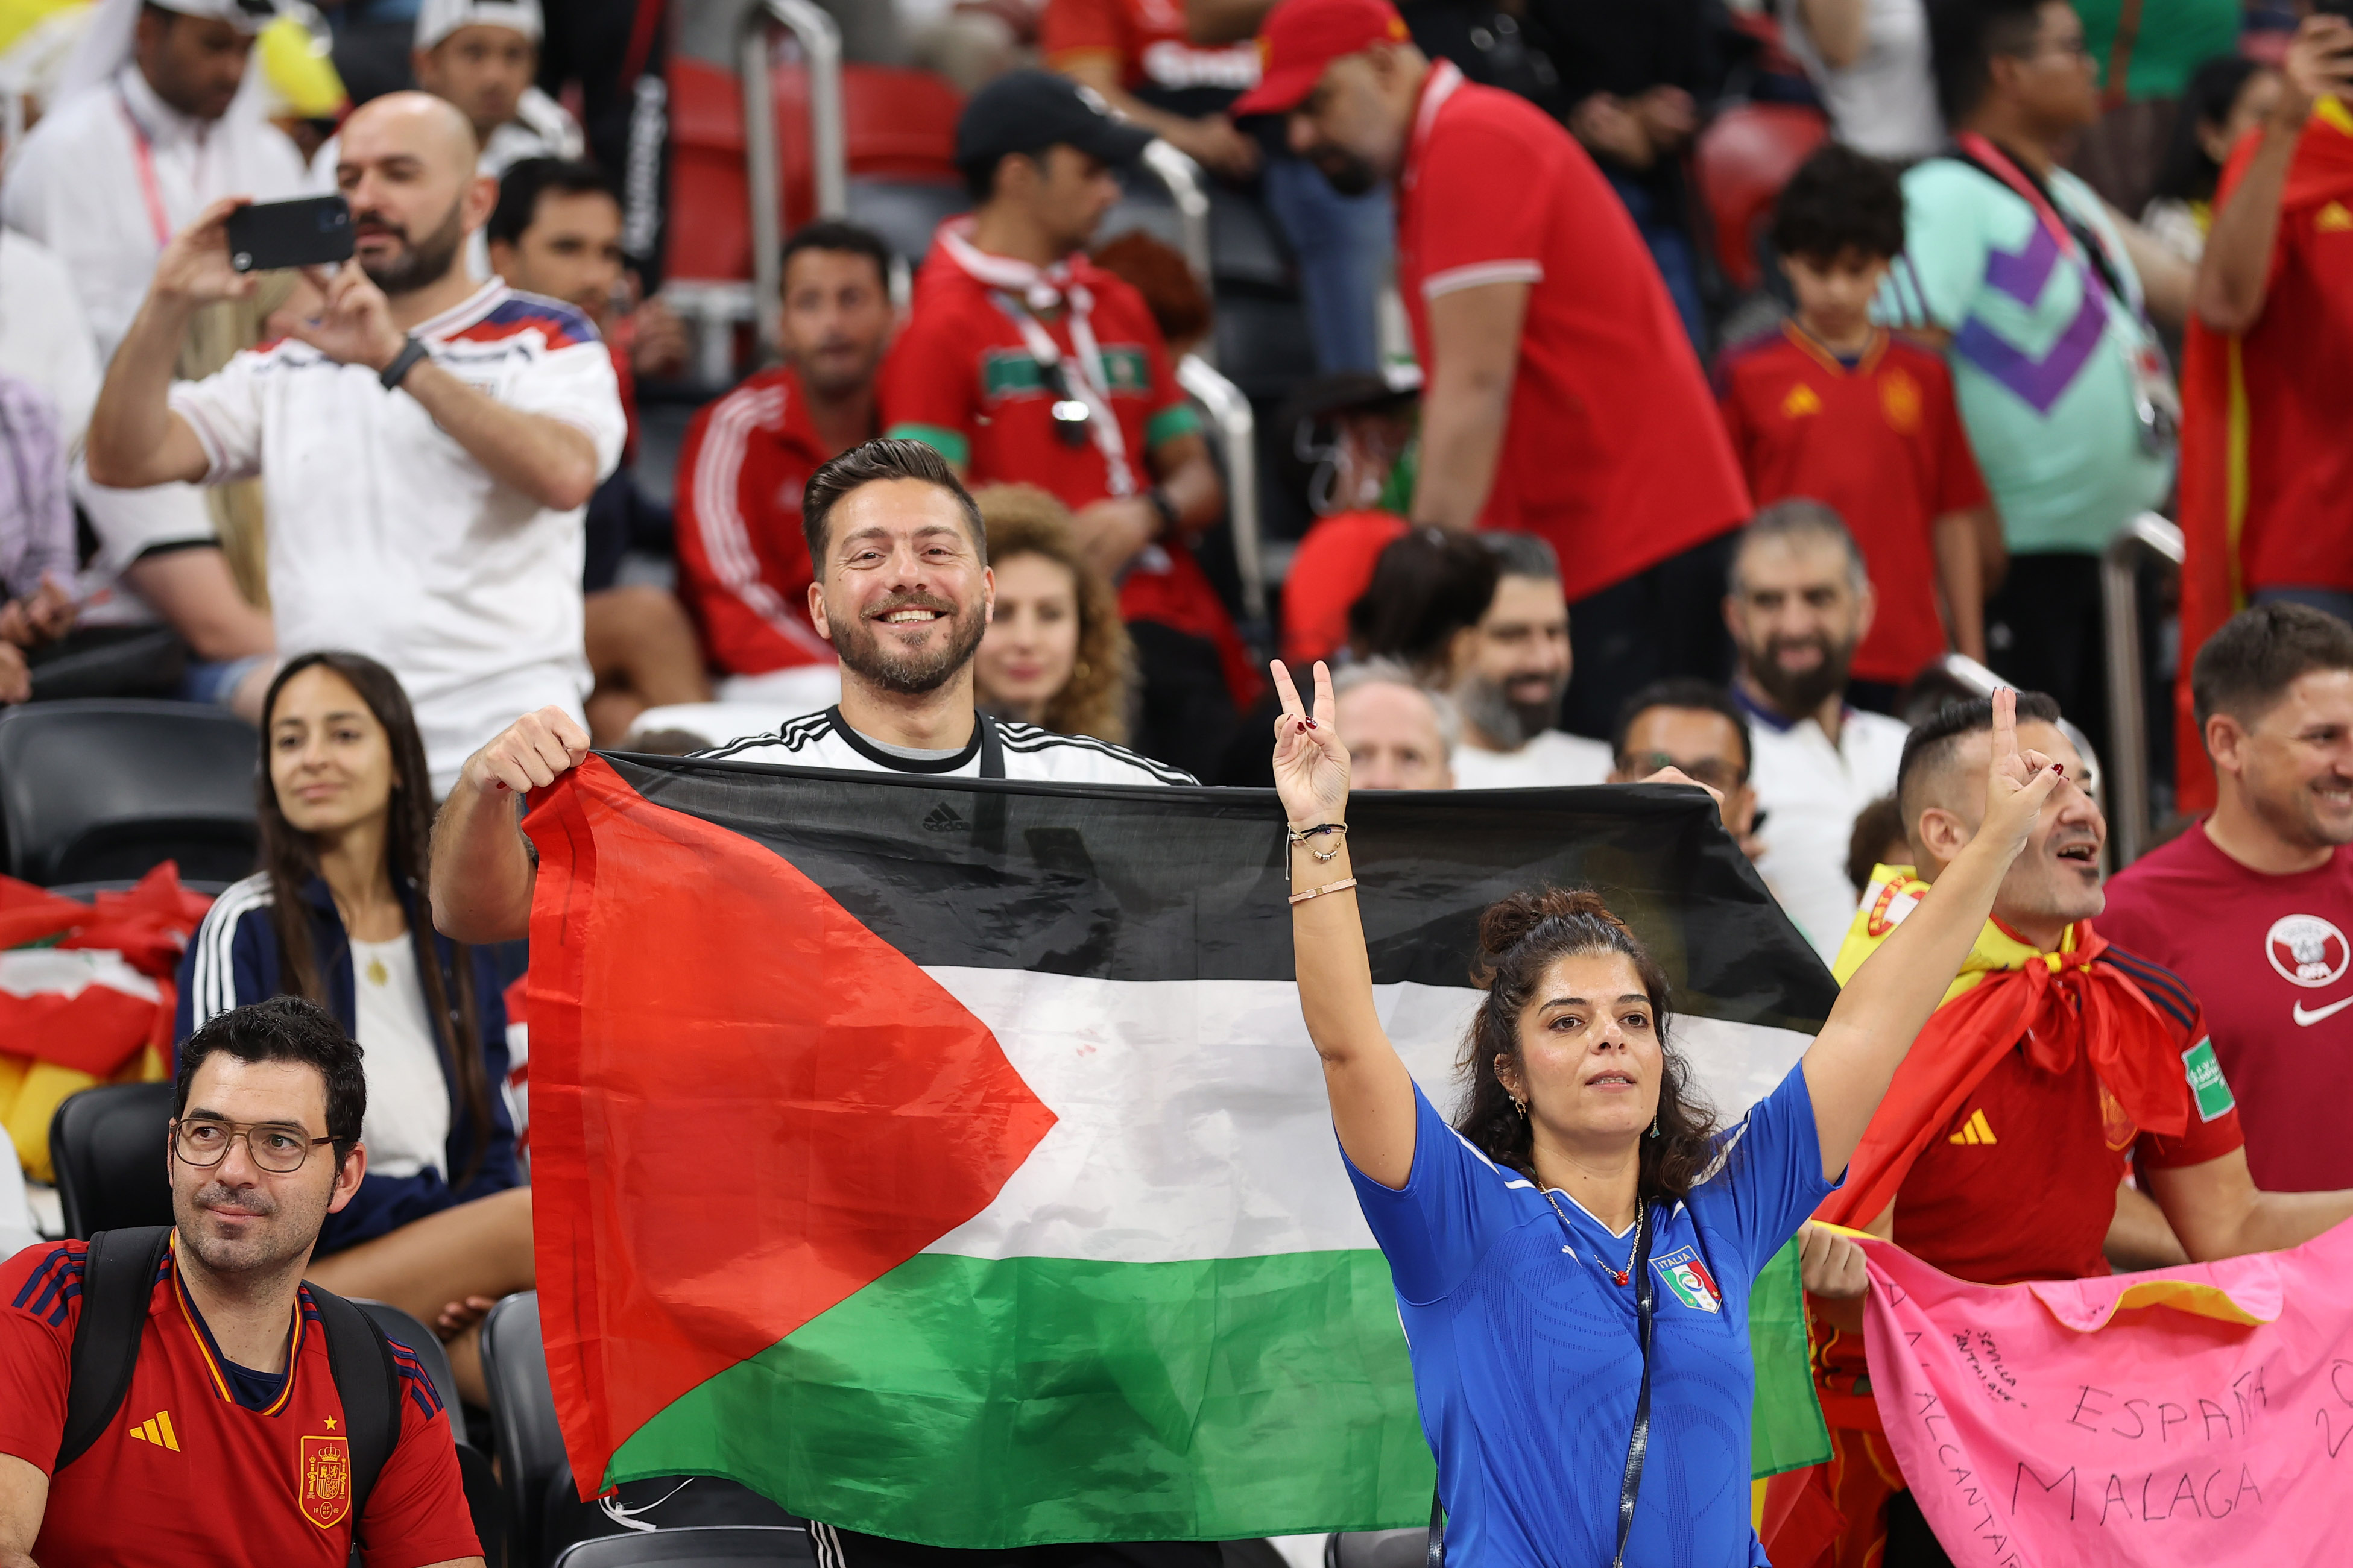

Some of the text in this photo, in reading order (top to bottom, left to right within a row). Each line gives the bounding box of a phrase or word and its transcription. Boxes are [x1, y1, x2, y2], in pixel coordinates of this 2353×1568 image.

[921, 821, 971, 833] adidas
[1658, 1253, 1692, 1269] ITALIA
[2065, 1365, 2267, 1443] ESPAÑA
[2011, 1461, 2263, 1526] MALAGA
